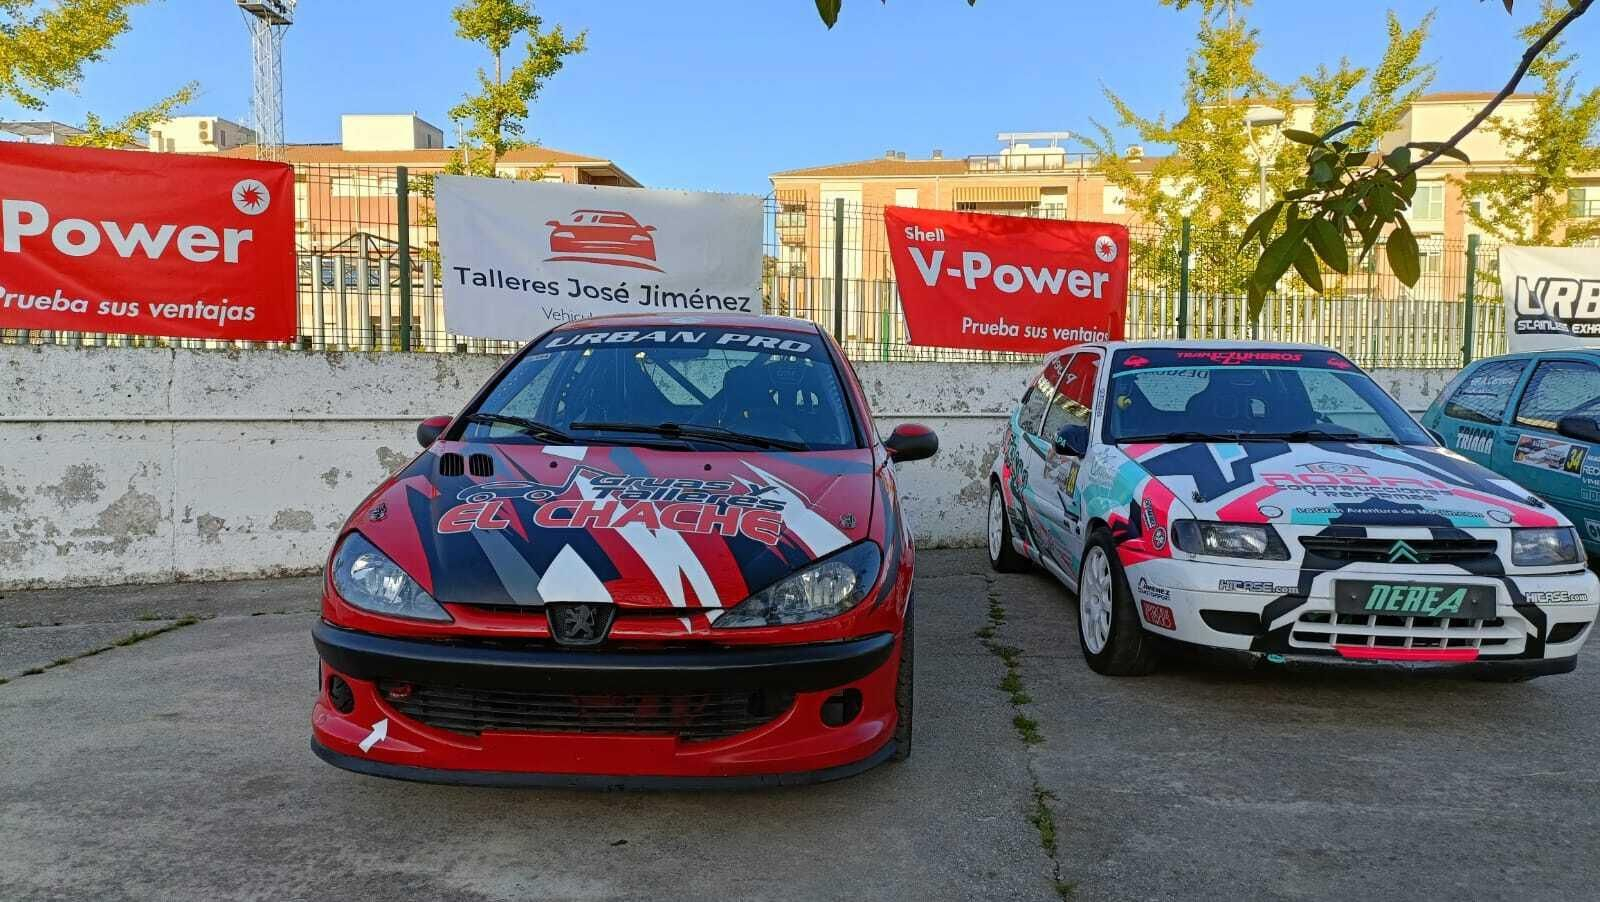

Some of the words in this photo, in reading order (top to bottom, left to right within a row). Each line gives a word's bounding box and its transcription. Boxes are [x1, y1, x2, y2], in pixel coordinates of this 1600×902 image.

[2, 199, 253, 264] Power
[904, 226, 945, 242] Shell
[907, 246, 1109, 299] V-Power
[453, 266, 560, 296] Talleres
[567, 278, 630, 304] José
[638, 284, 752, 313] Jiménez
[97, 301, 140, 319] sus
[148, 298, 256, 327] ventajas
[545, 330, 706, 349] URBAN
[716, 332, 812, 353] PRO
[962, 316, 1019, 338] Prueba
[1023, 325, 1048, 340] sus
[1052, 326, 1109, 343] ventajas
[590, 474, 734, 491] Gruas
[592, 486, 787, 512] Talleres
[437, 498, 511, 534] EL
[533, 498, 784, 547] CHACHE
[1364, 584, 1469, 617] NEREA
